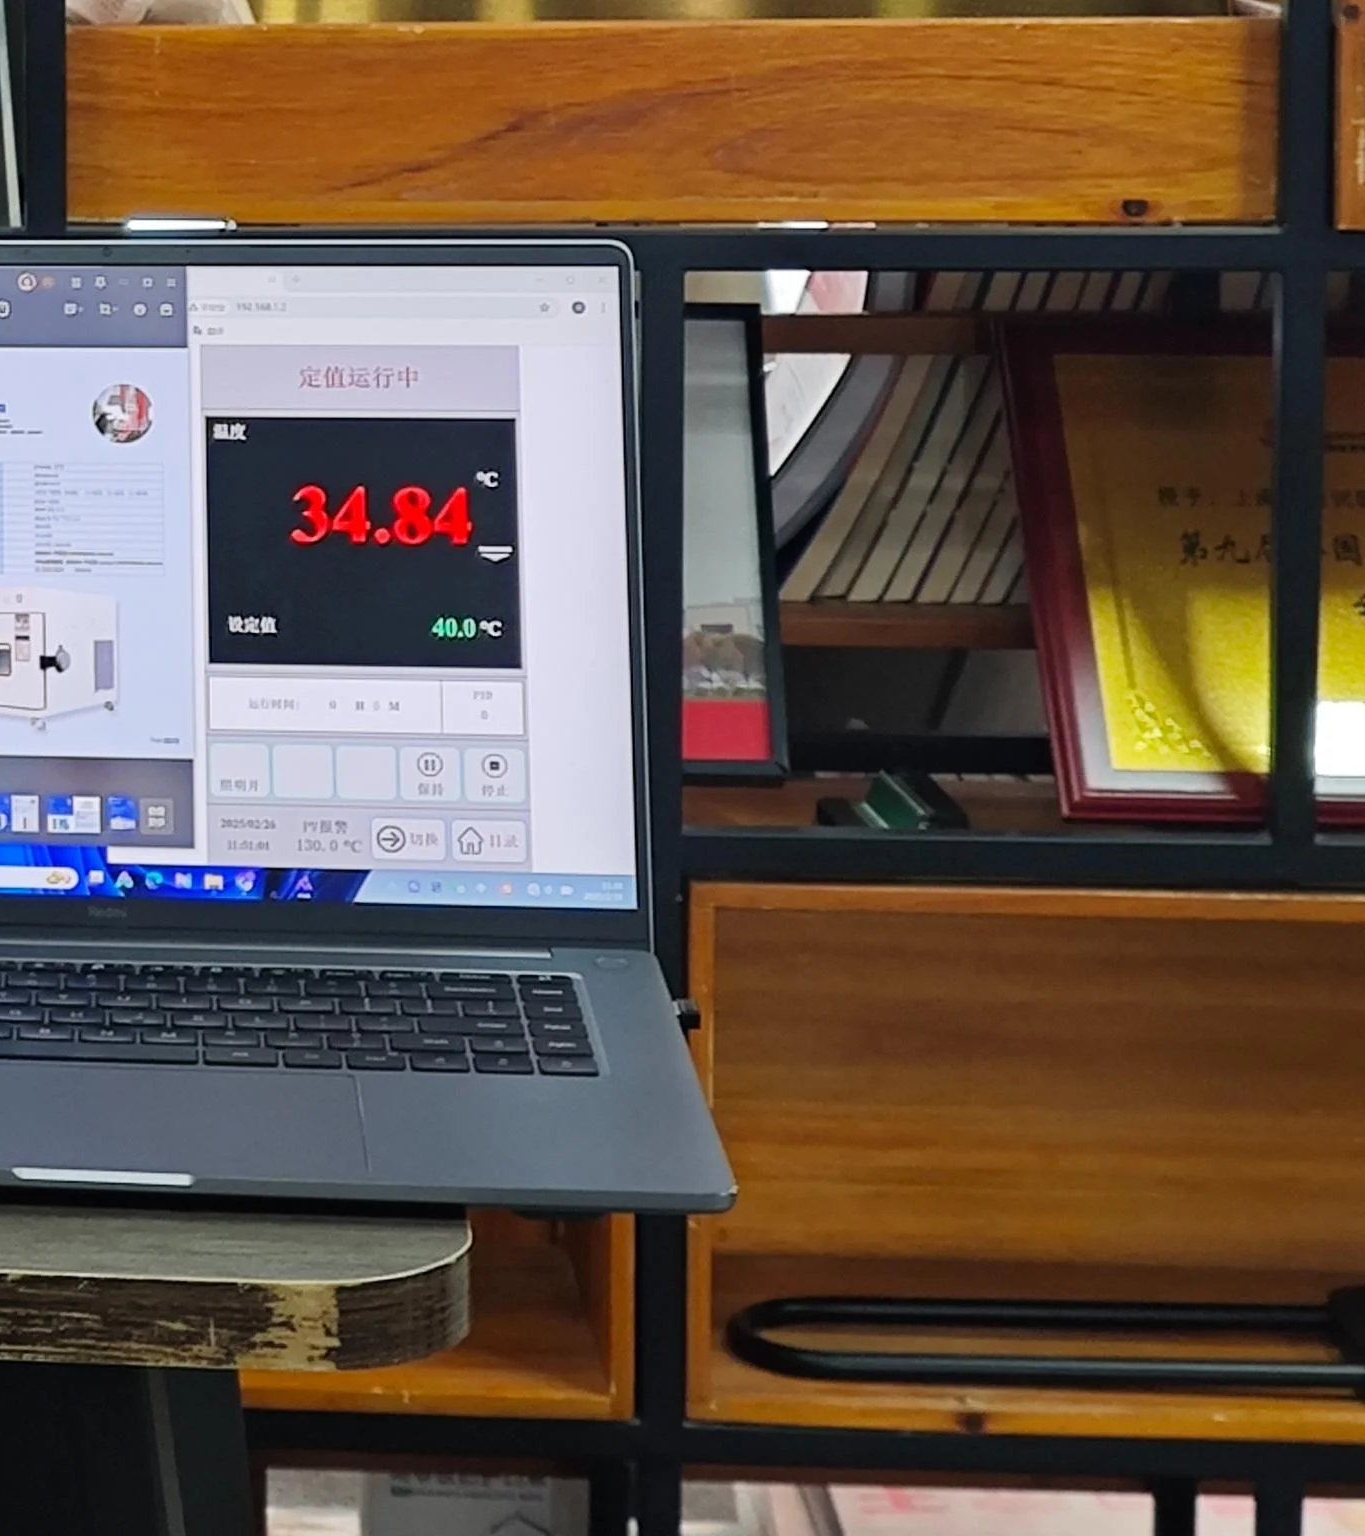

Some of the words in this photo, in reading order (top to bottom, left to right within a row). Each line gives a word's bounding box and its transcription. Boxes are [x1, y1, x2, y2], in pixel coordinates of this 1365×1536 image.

[297, 366, 420, 390] 定值运行中
[213, 422, 247, 441] 温度
[289, 484, 474, 547] 34.84
[227, 615, 279, 636] 设定值
[417, 782, 445, 797] 保持
[481, 784, 509, 798] 停止
[408, 831, 439, 847] 切换
